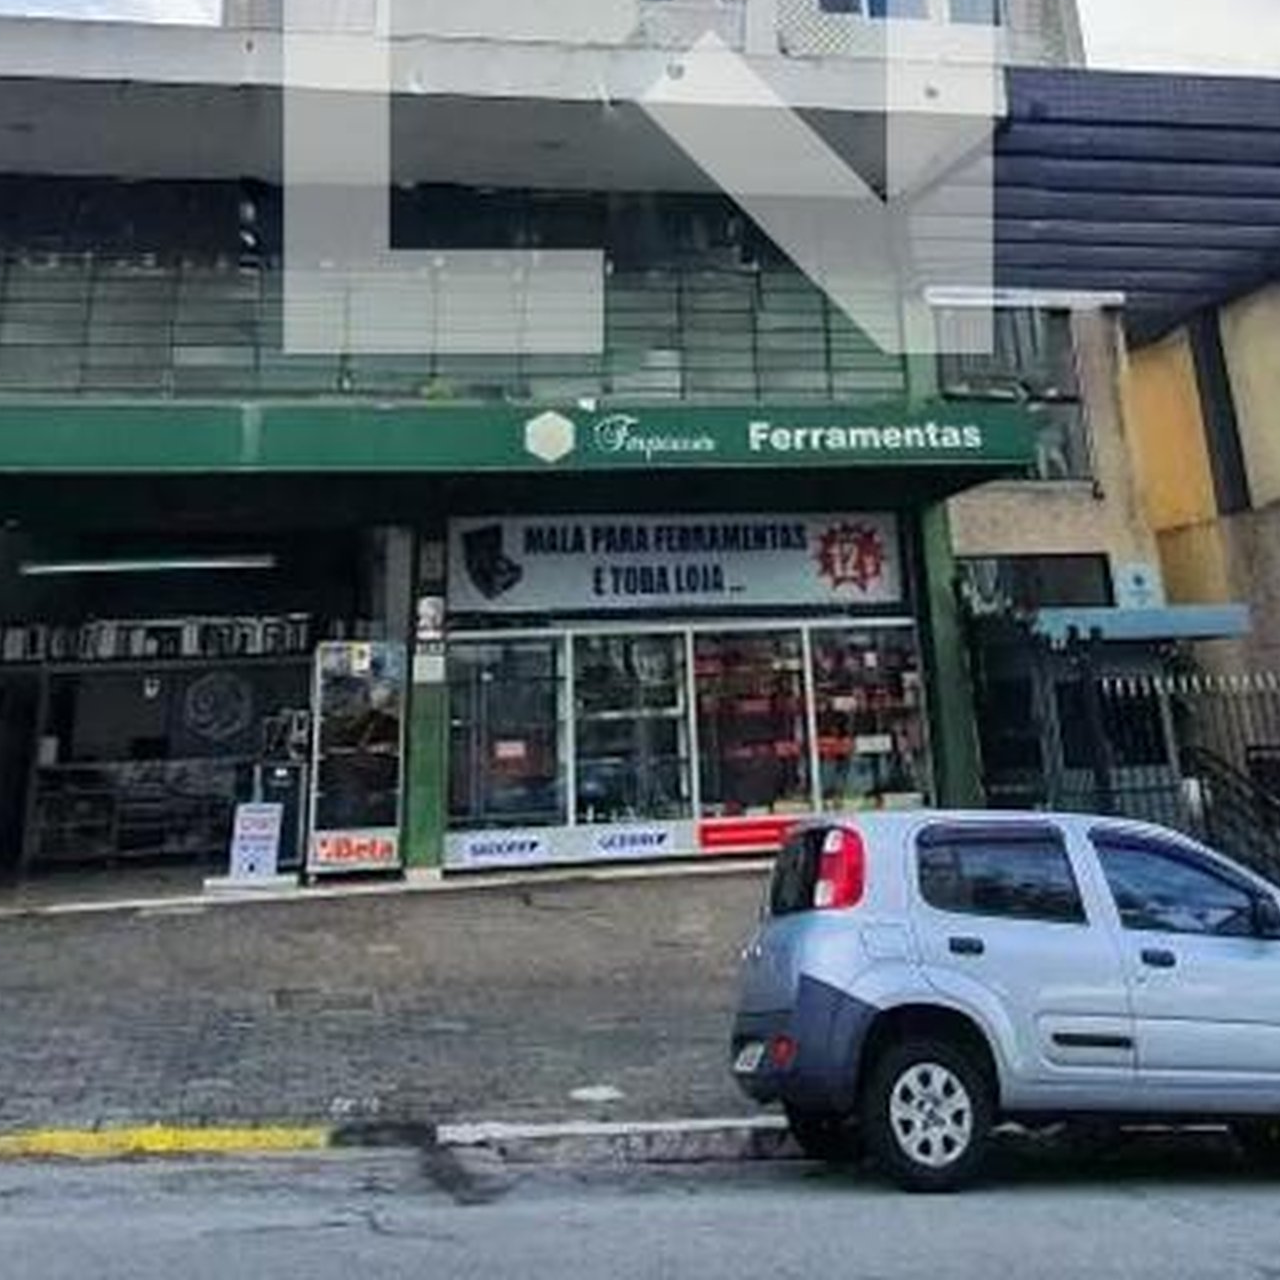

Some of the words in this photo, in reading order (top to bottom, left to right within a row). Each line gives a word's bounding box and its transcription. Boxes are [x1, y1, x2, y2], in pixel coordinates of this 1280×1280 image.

[748, 422, 983, 452] Ferramentas
[523, 524, 585, 554] MALA
[591, 524, 650, 553] PARA
[654, 523, 807, 552] FERRAMENTAS
[593, 567, 604, 596] E
[611, 565, 669, 595] TODA
[675, 564, 725, 593] LOJA
[335, 837, 394, 860] Beta
